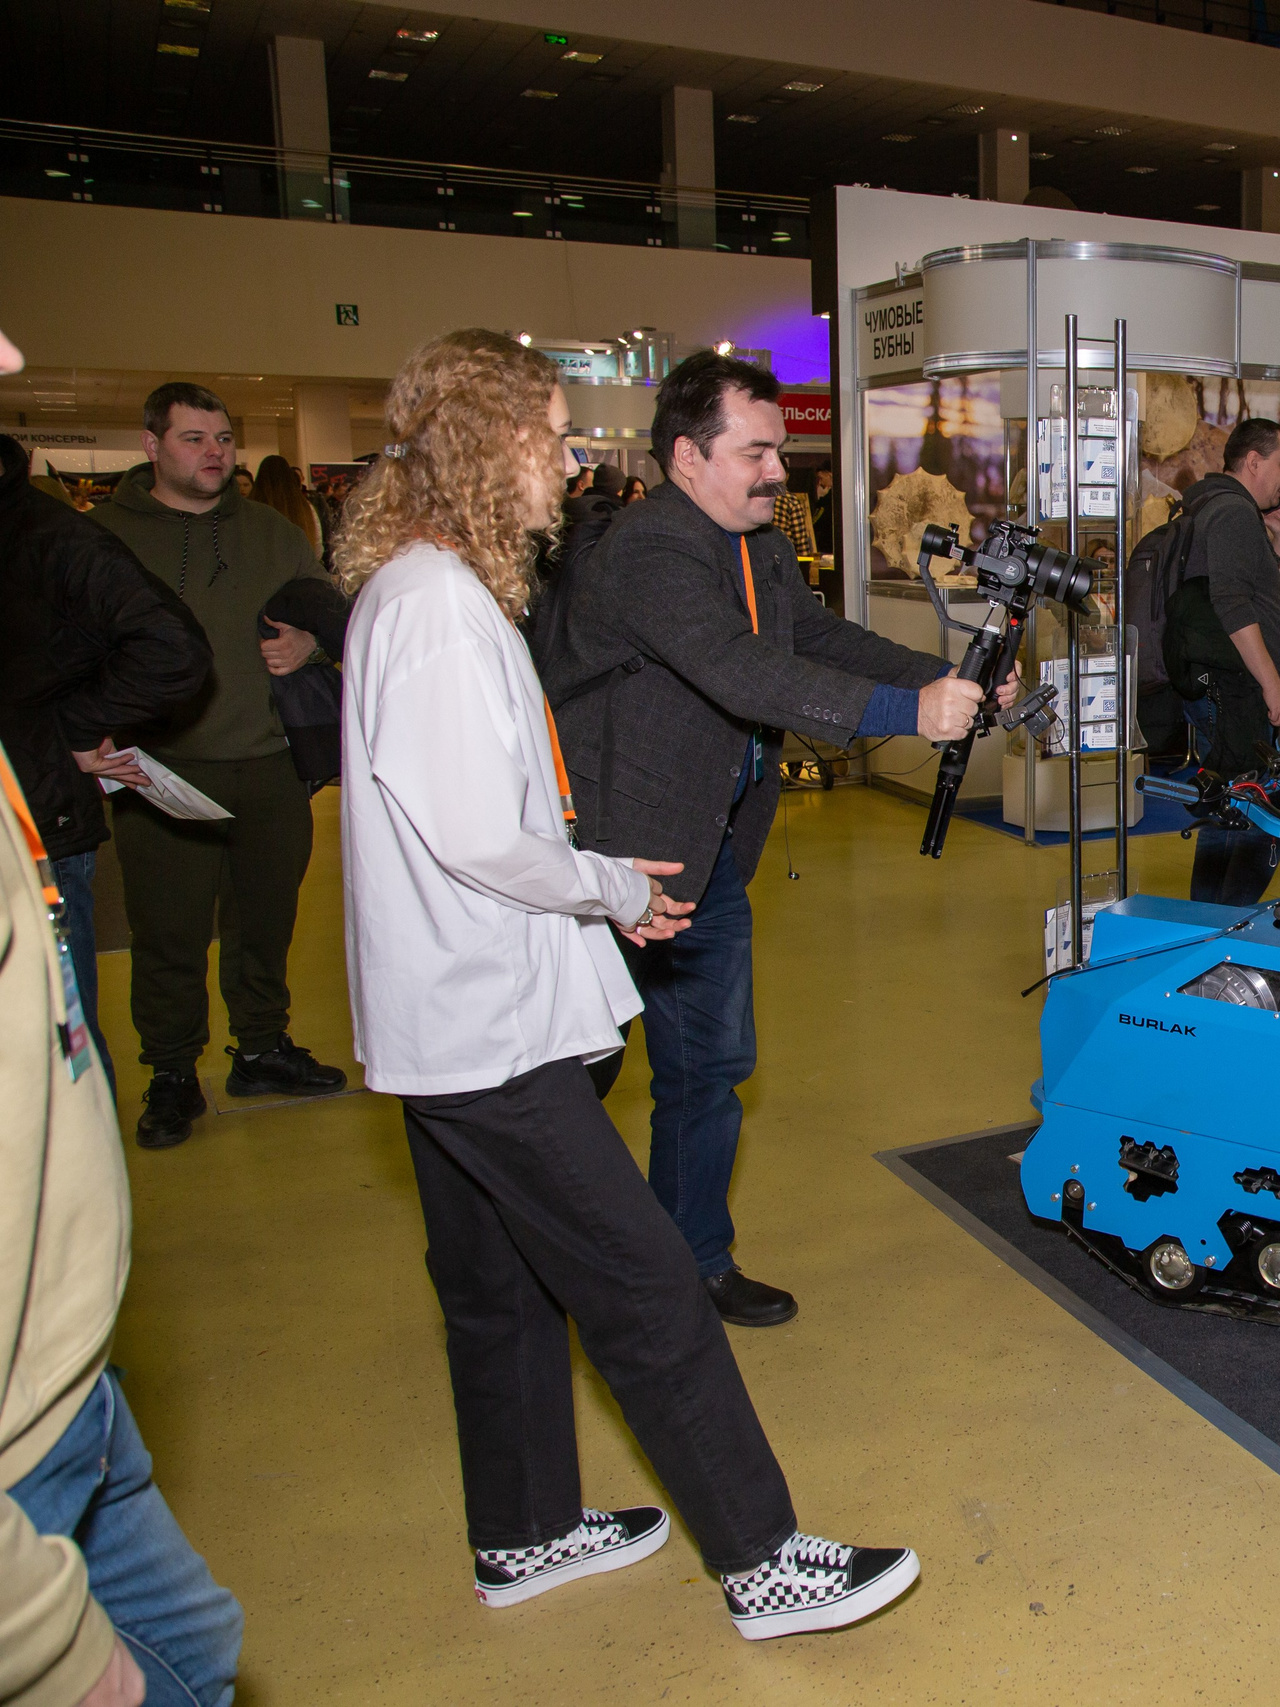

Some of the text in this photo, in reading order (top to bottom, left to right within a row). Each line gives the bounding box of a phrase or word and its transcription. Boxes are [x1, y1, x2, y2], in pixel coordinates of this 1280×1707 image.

[865, 300, 923, 333] ЧУМОВЫЕ
[874, 331, 914, 360] БУБНЫ
[30, 434, 97, 444] КОНСЕРВЫ
[1119, 1013, 1197, 1038] BURLAK
